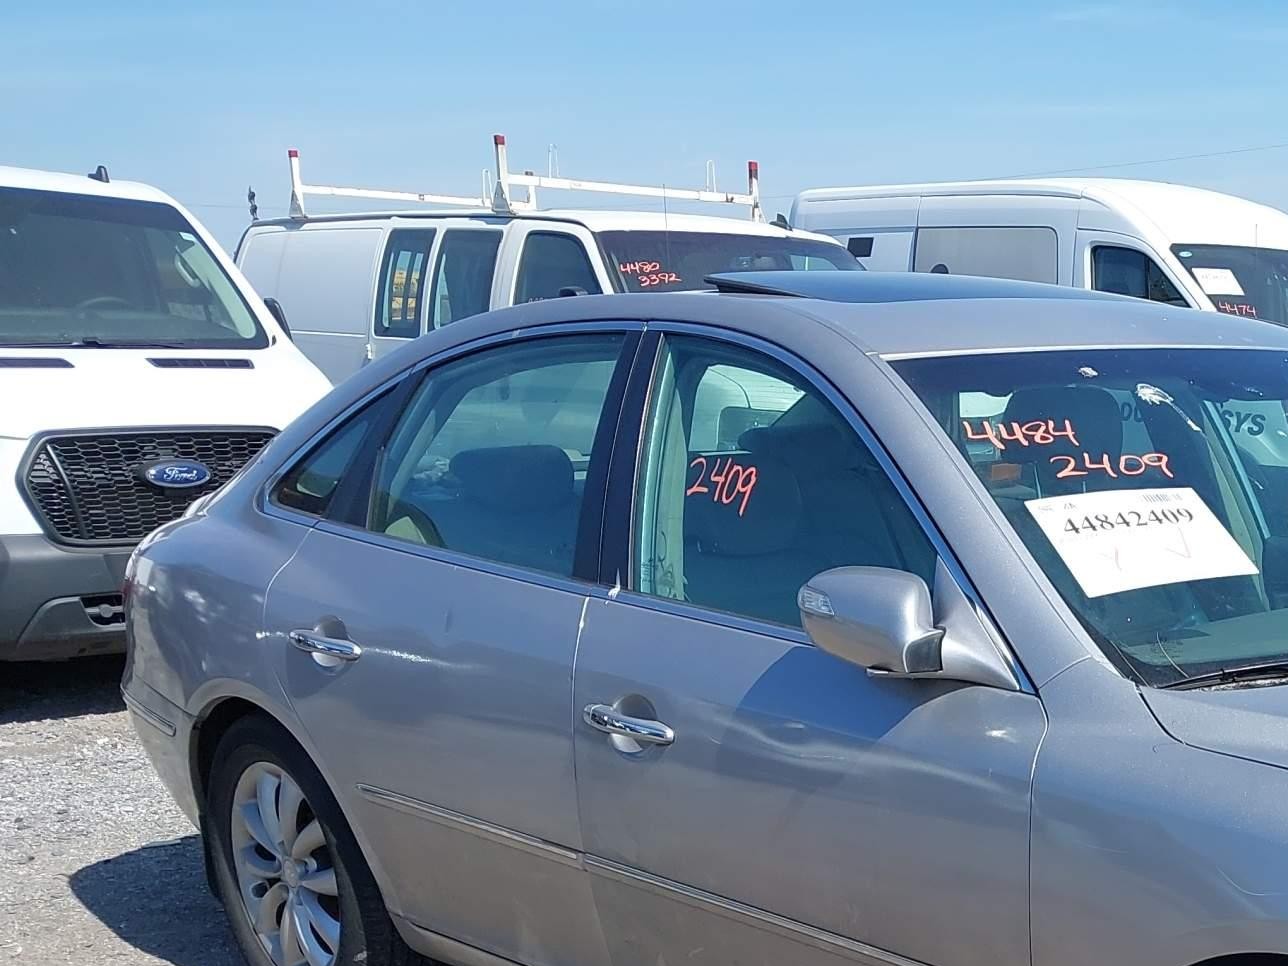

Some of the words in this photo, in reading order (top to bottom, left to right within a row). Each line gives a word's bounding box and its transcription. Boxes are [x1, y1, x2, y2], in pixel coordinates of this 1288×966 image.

[962, 419, 1081, 450] 4484
[163, 466, 198, 481] Ford
[1049, 452, 1174, 479] 2409
[686, 457, 757, 517] 2409
[1064, 508, 1194, 535] 44842409
